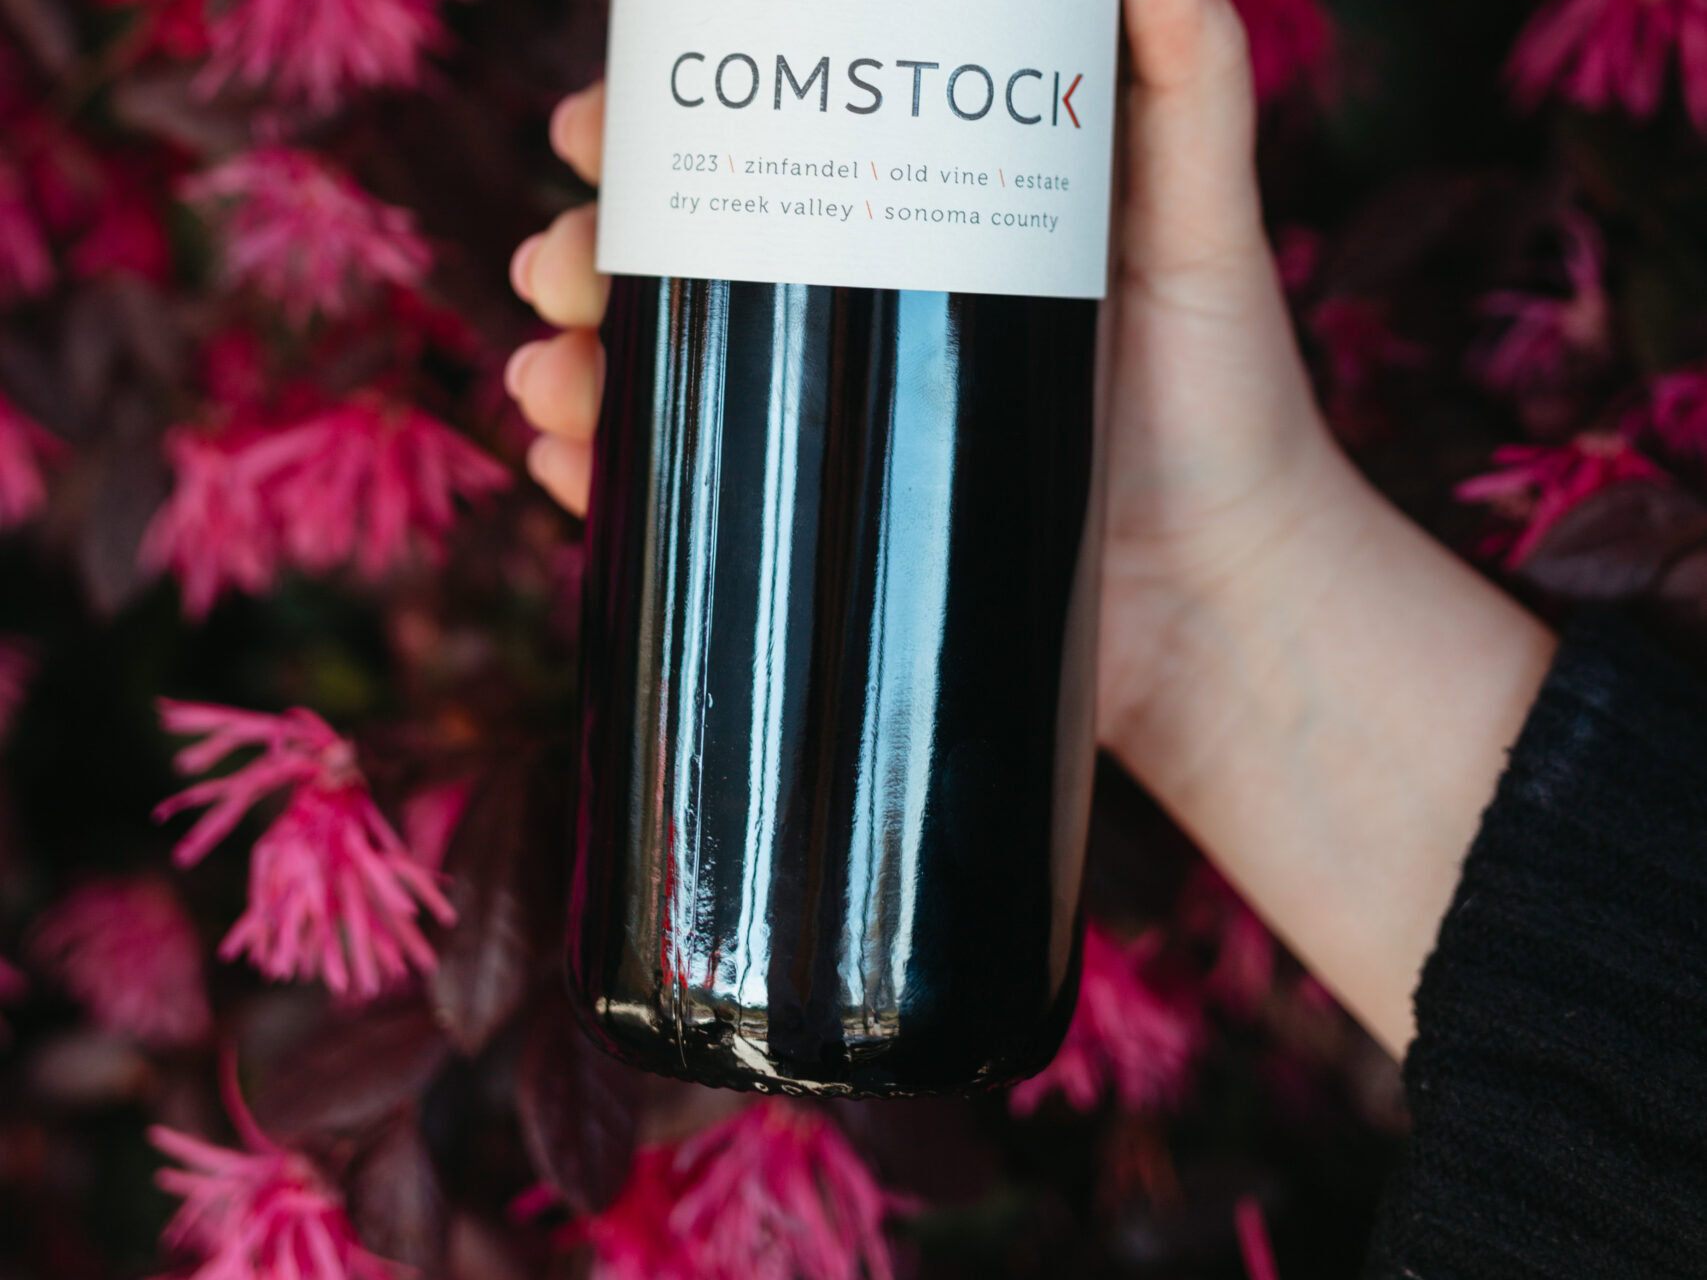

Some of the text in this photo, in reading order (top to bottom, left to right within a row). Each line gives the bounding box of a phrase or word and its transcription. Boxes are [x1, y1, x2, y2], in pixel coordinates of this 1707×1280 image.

[669, 50, 1084, 130] COMSTOCK
[671, 152, 719, 173] 2023
[744, 156, 859, 179] zinfandel
[889, 163, 928, 183] old
[939, 166, 990, 186] vine
[1014, 173, 1071, 192] estate
[669, 191, 701, 215] dry
[709, 195, 769, 214] creek
[780, 197, 854, 223] valley
[884, 205, 981, 225] sonoma
[990, 212, 1060, 233] county
